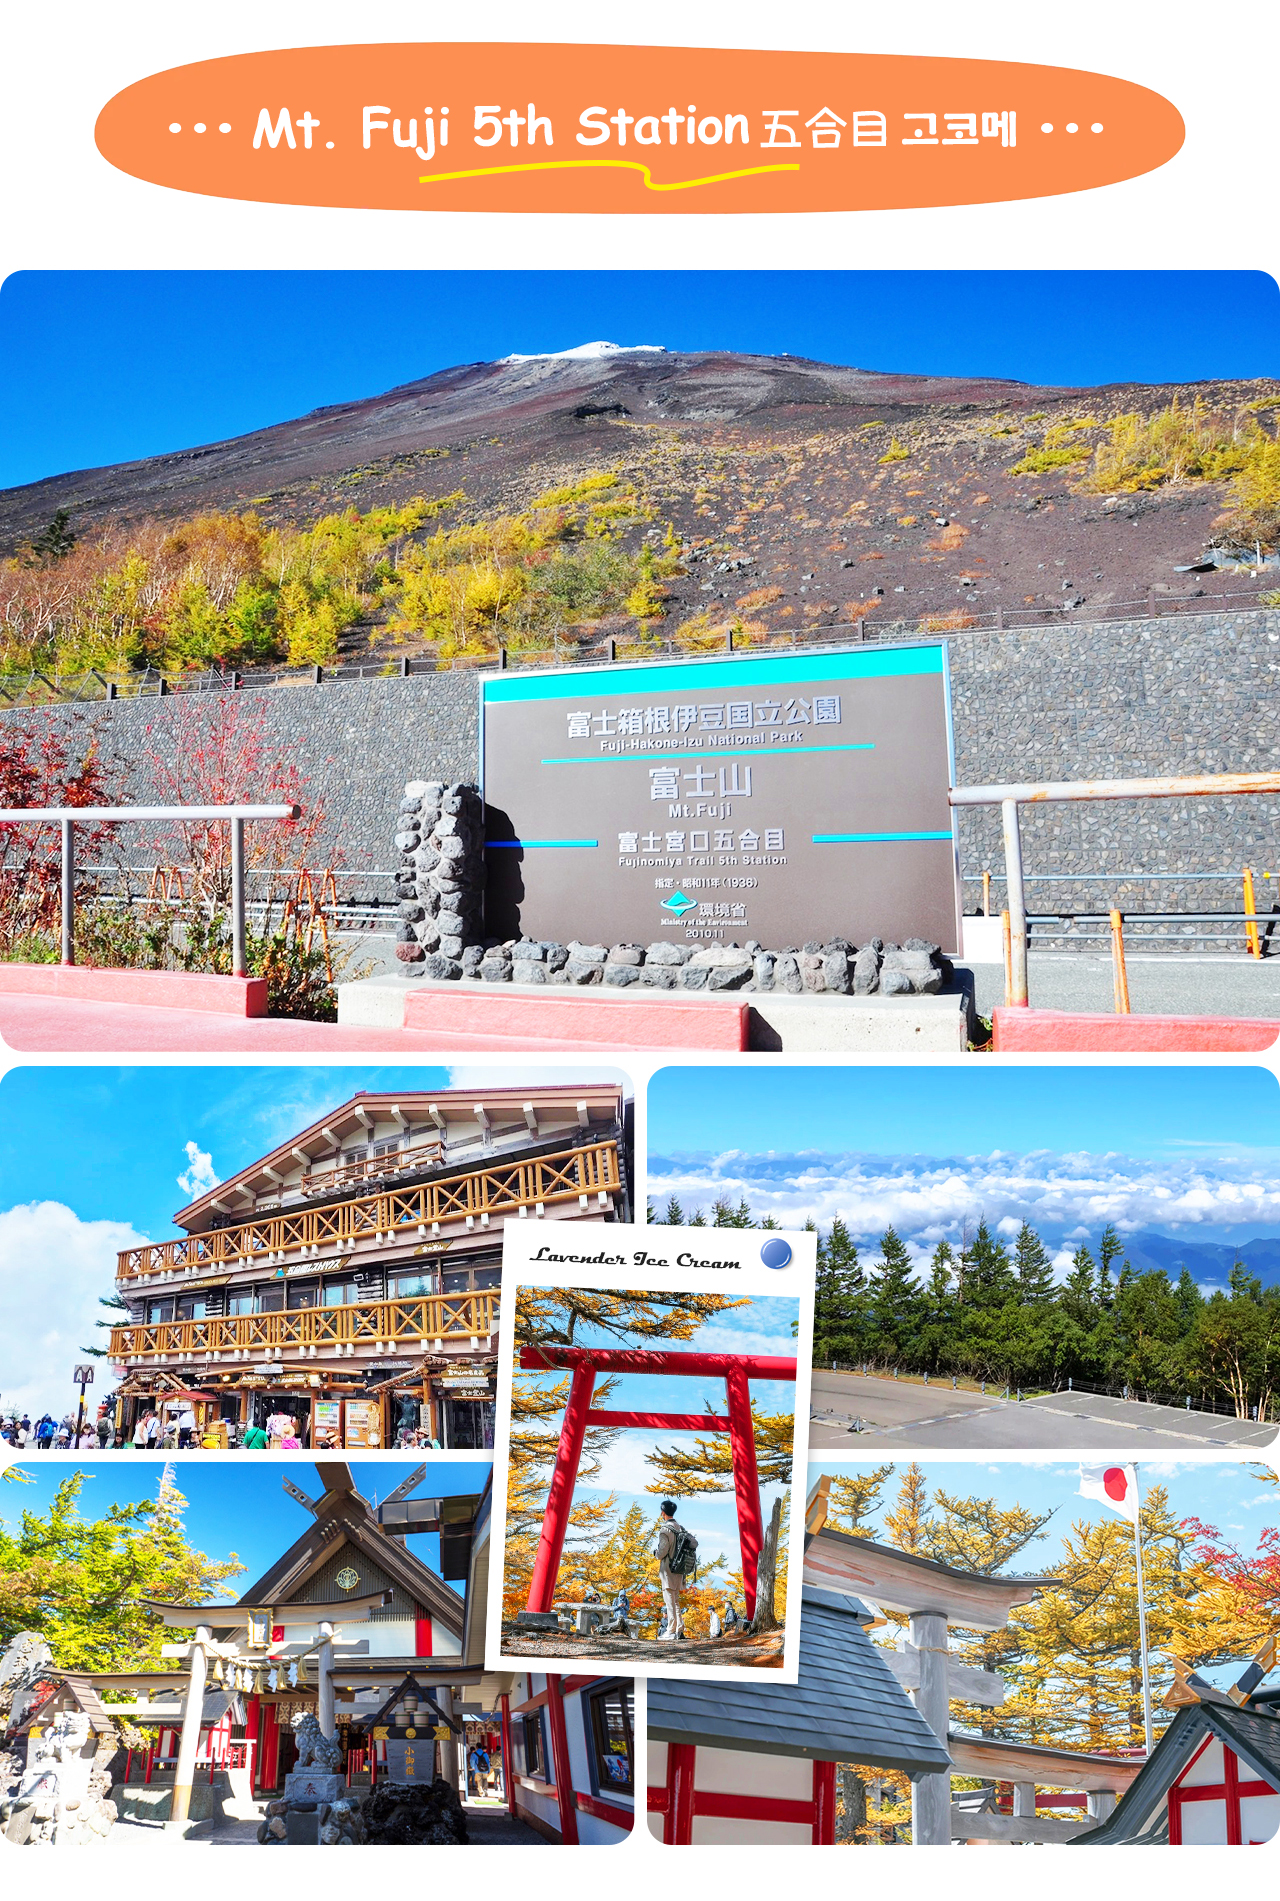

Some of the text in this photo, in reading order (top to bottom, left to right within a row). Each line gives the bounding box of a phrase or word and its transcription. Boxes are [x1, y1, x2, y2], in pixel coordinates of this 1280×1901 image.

[566, 695, 842, 739] 富士箱根伊豆国立公園
[600, 730, 804, 754] Fuji-Hakone-Izu National Park
[648, 762, 753, 801] 富士山
[668, 802, 733, 820] Mt.Fuji
[617, 828, 786, 854] 富士宮口五合目
[618, 854, 788, 869] Fujinomiya Trail 5th Station
[698, 902, 747, 919] 環境省
[660, 918, 688, 928] Ministry
[696, 918, 707, 927] the
[707, 918, 749, 927] Environment
[685, 929, 725, 939] 2010.11
